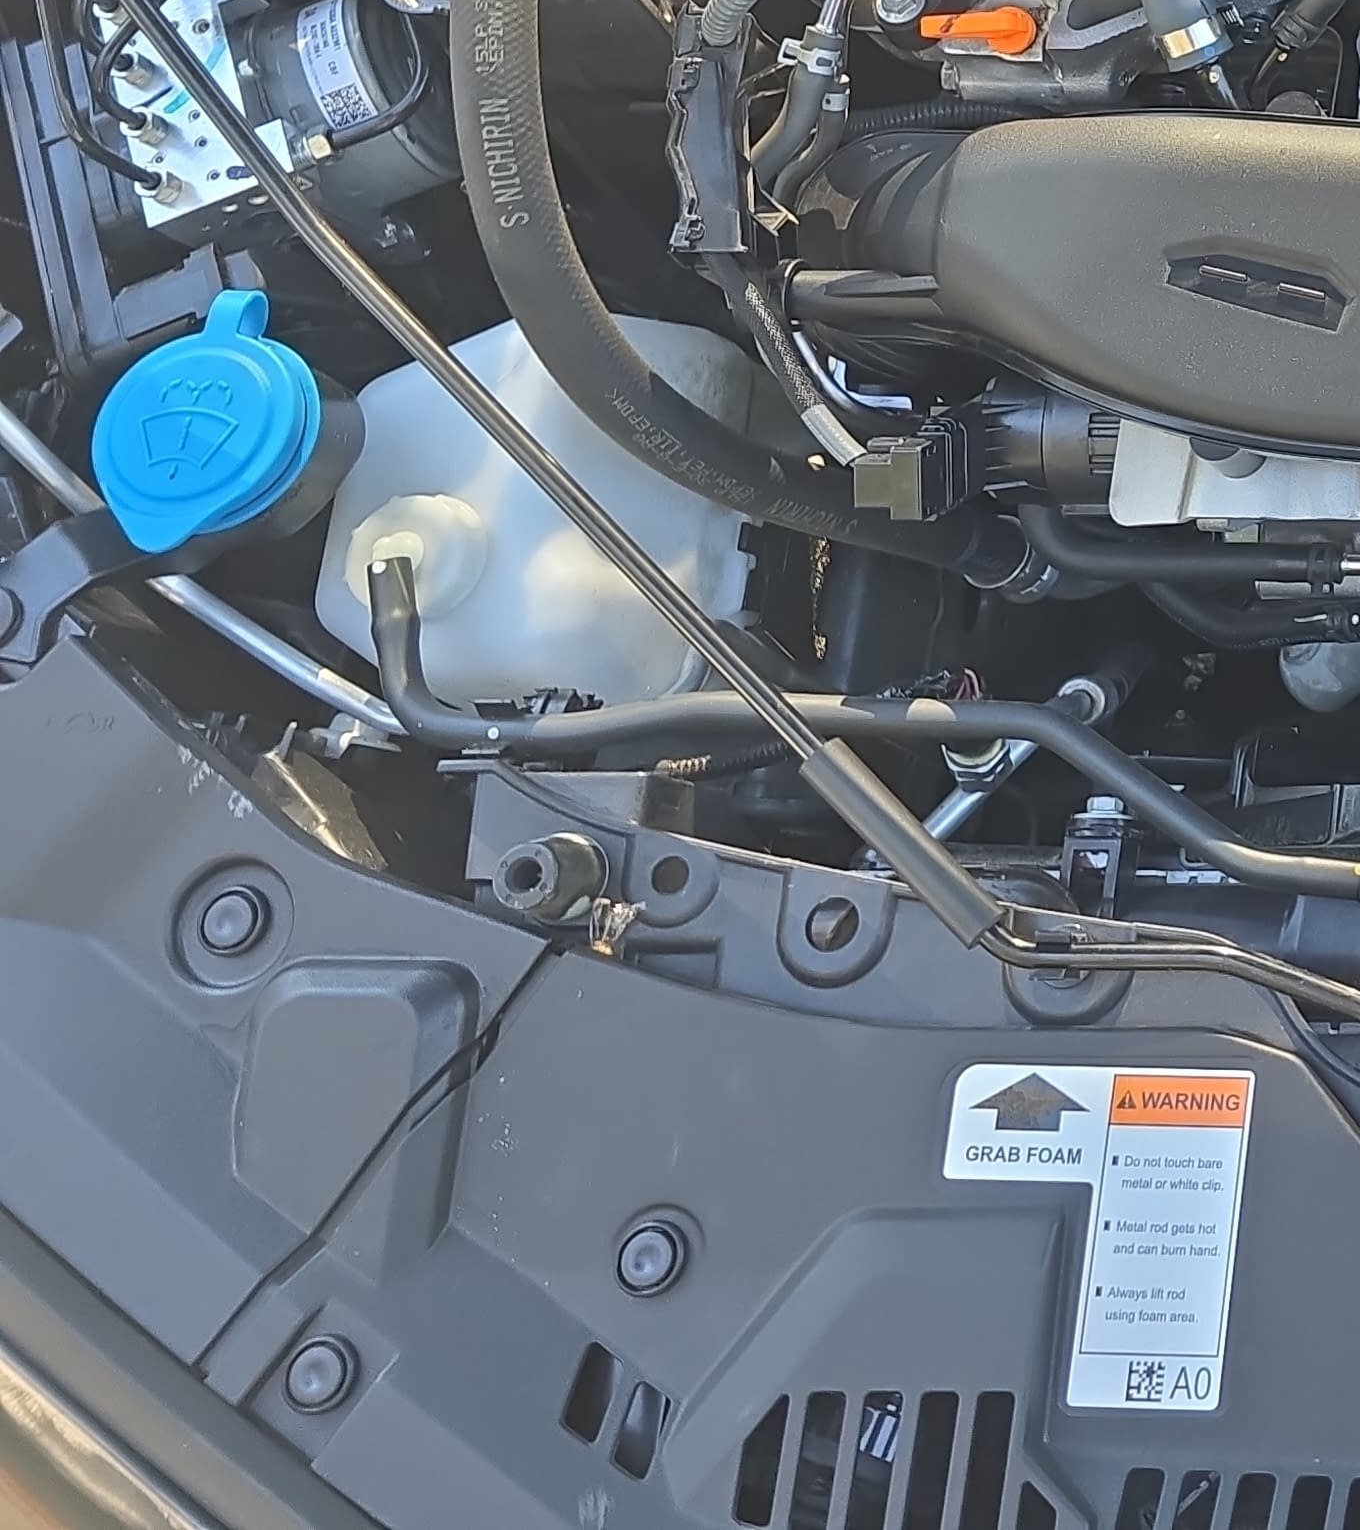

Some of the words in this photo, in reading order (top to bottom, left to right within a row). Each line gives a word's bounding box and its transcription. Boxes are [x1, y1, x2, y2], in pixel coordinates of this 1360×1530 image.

[1142, 1092, 1240, 1111] WARNING
[965, 1145, 1021, 1163] GRAB
[1026, 1147, 1082, 1165] FOAM
[1124, 1155, 1141, 1168] Do
[1143, 1156, 1161, 1168] not
[1164, 1156, 1195, 1169] touch
[1198, 1157, 1223, 1169] bare
[1121, 1178, 1152, 1189] metal
[1155, 1180, 1167, 1190] or
[1169, 1178, 1199, 1190] white
[1201, 1179, 1224, 1192] clip.
[1116, 1220, 1147, 1232] Metal
[1150, 1222, 1168, 1233] rod
[1171, 1223, 1195, 1236] gets
[1198, 1223, 1216, 1234] hot
[1113, 1242, 1135, 1254] and
[1137, 1245, 1158, 1255] can
[1161, 1244, 1187, 1256] burn
[1189, 1245, 1220, 1257] hand.
[1107, 1286, 1148, 1301] Always
[1150, 1288, 1164, 1300] lift
[1167, 1289, 1185, 1300] rod
[1105, 1310, 1135, 1323] using
[1138, 1309, 1166, 1322] foam
[1169, 1312, 1199, 1323] area.
[1169, 1365, 1212, 1400] A0
